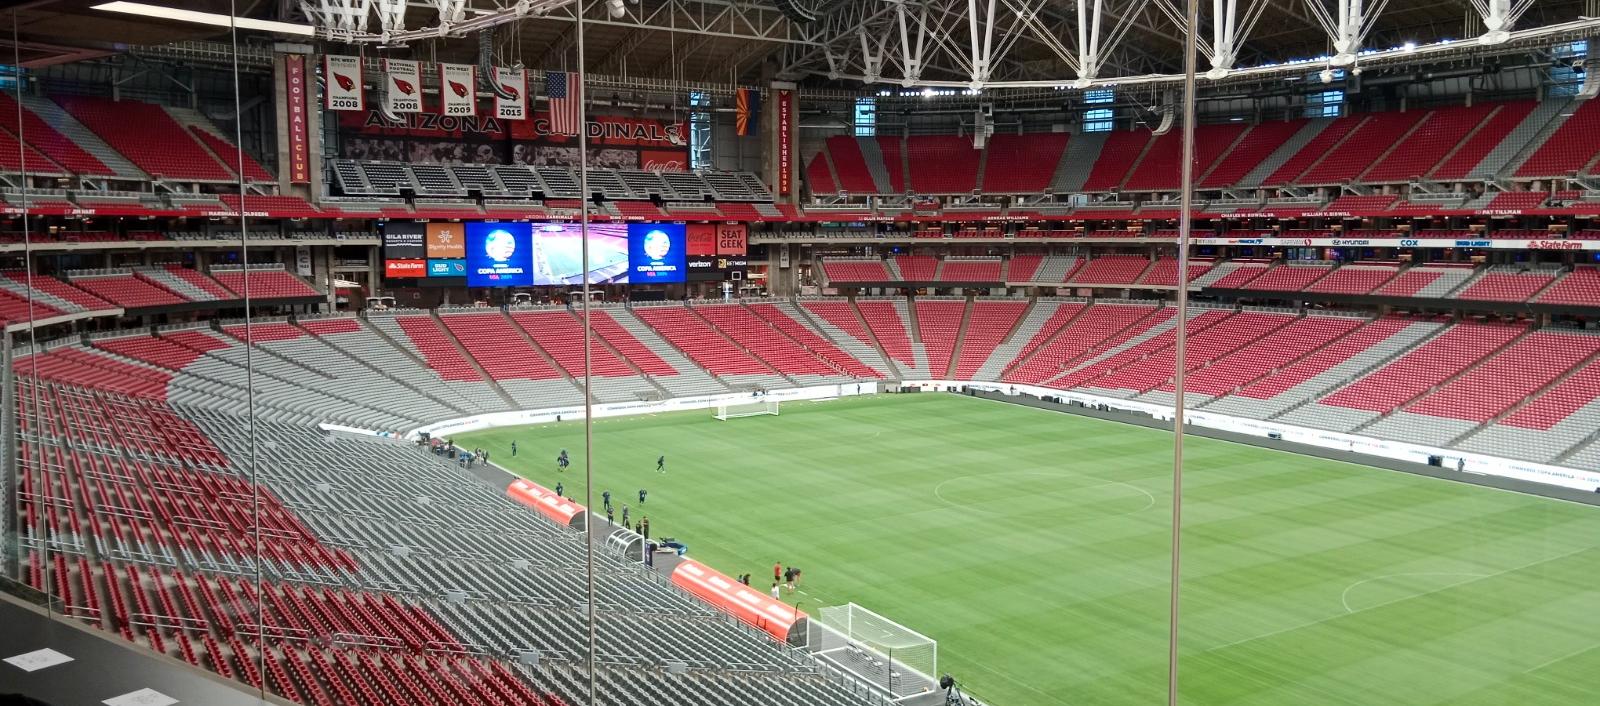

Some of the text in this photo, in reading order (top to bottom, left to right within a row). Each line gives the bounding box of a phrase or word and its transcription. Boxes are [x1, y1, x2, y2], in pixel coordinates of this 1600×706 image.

[500, 108, 522, 116] 2015
[292, 67, 304, 180] FOOTBALL CLUB
[720, 230, 742, 239] SEAT
[720, 240, 743, 248] GEEK
[1540, 240, 1582, 249] State Farm
